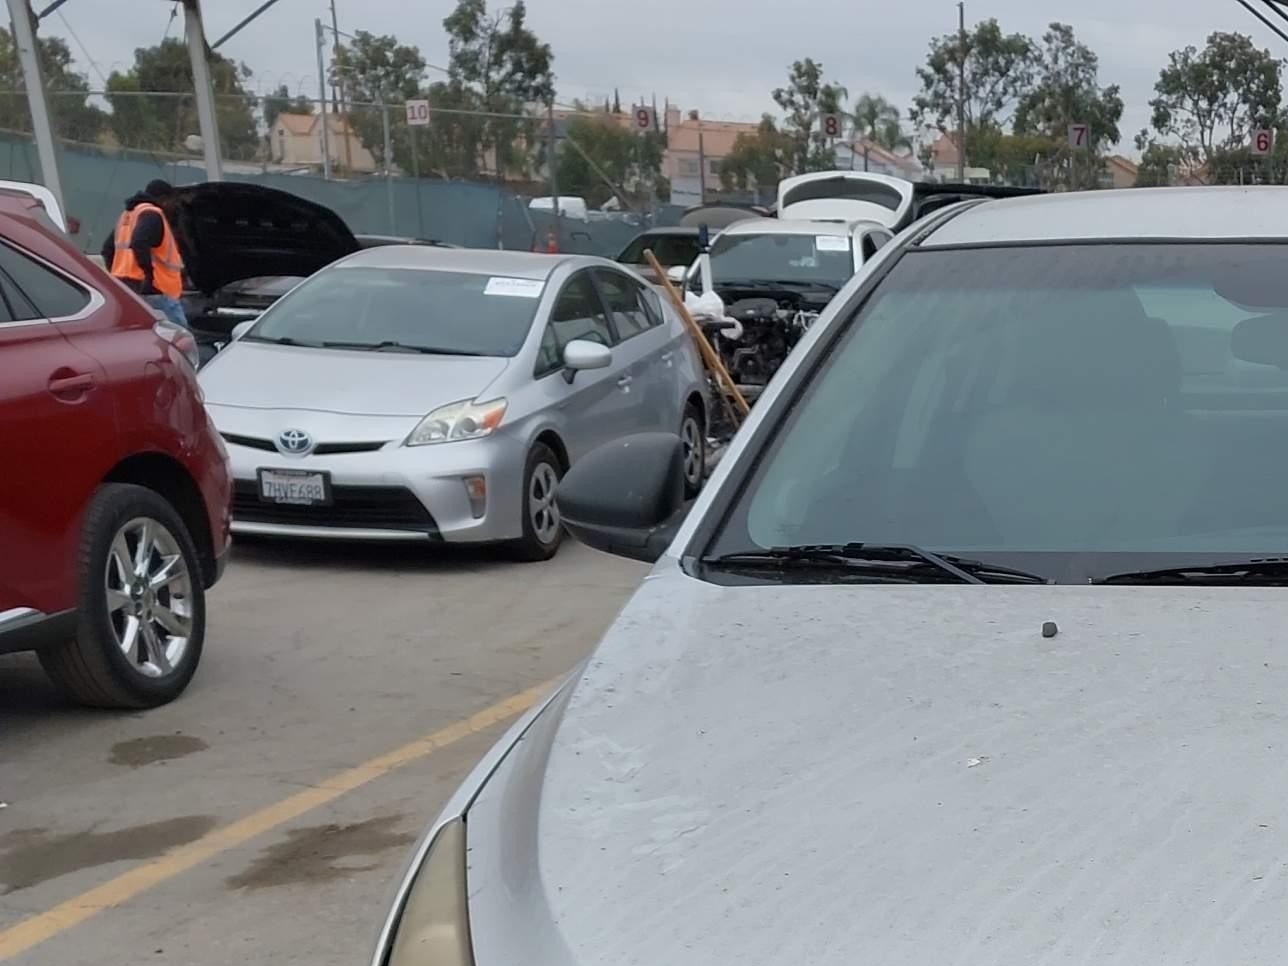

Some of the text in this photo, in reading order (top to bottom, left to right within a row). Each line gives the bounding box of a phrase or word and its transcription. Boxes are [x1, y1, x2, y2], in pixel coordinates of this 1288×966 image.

[409, 104, 428, 120] 10
[636, 110, 649, 127] 9
[825, 116, 837, 135] 8
[1073, 127, 1085, 146] 7
[1257, 133, 1268, 151] 6
